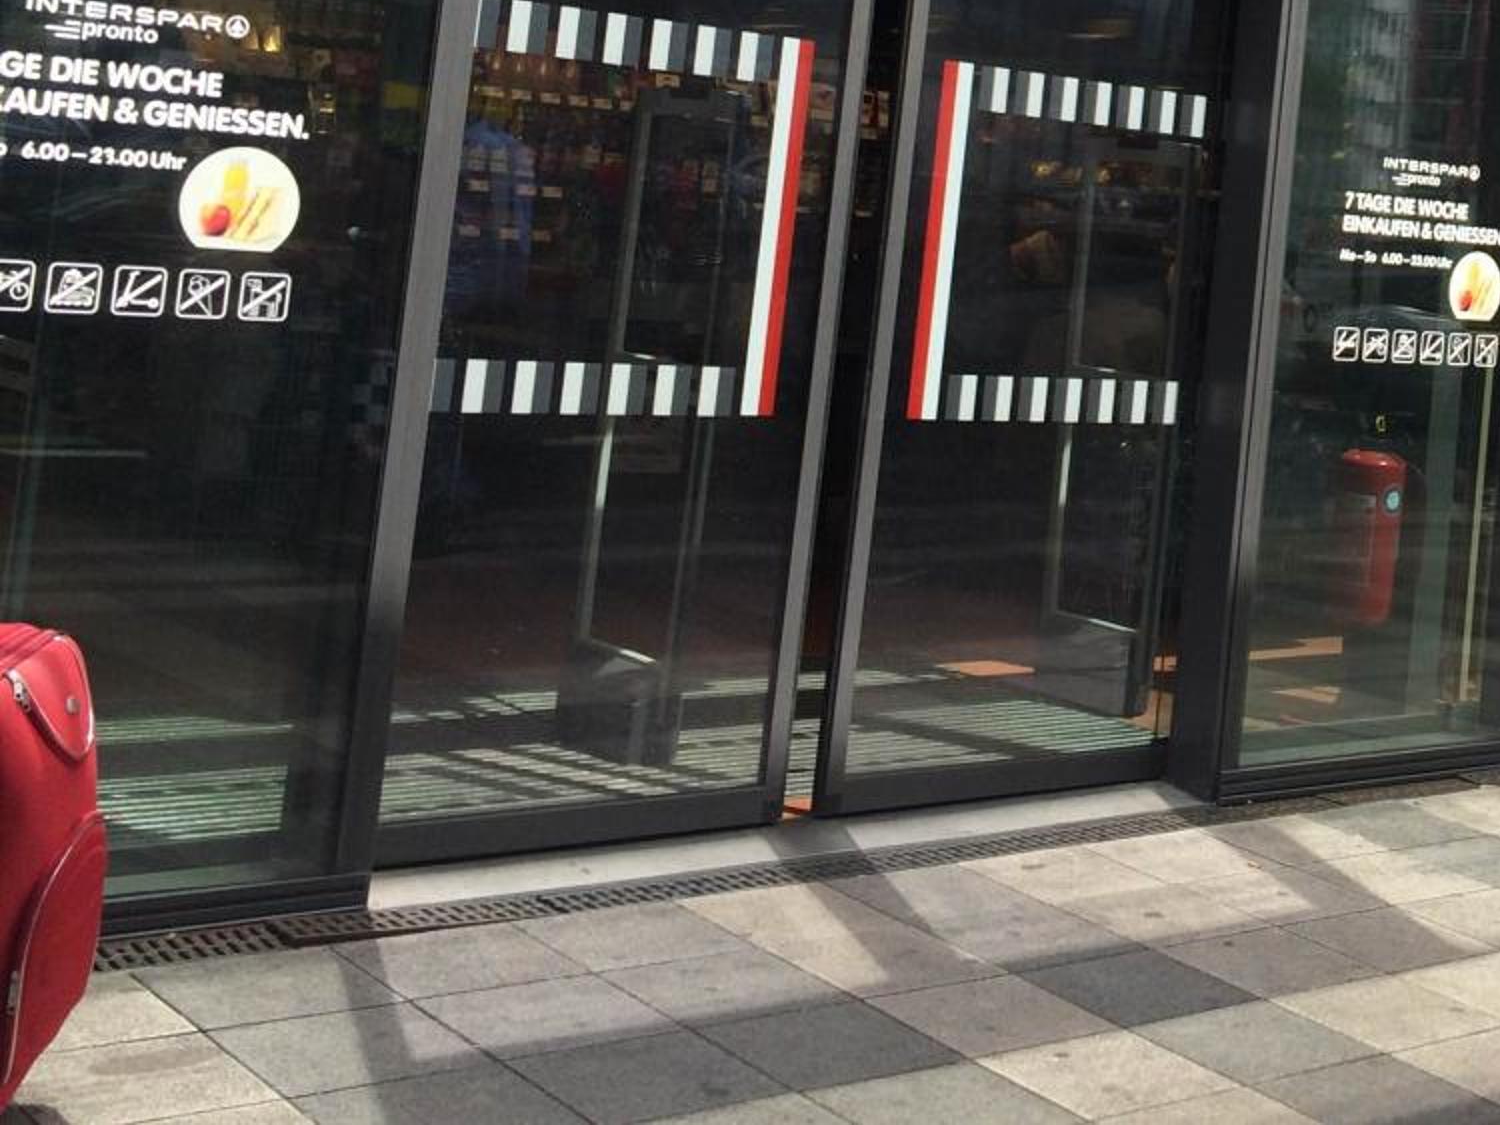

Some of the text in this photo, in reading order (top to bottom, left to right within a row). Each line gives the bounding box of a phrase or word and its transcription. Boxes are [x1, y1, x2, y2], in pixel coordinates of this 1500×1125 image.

[81, 22, 159, 44] pronto
[50, 55, 100, 86] DIE
[107, 61, 224, 98] WOCHE
[0, 86, 310, 140] AUFEN & GENIESSEN.
[150, 151, 187, 171] Uhr
[1383, 156, 1468, 178] INTERSPAR
[1345, 191, 1469, 221] 7 TAGE DIE WOCHE
[1342, 215, 1420, 239] EINKAUFEN
[1421, 223, 1433, 240] &
